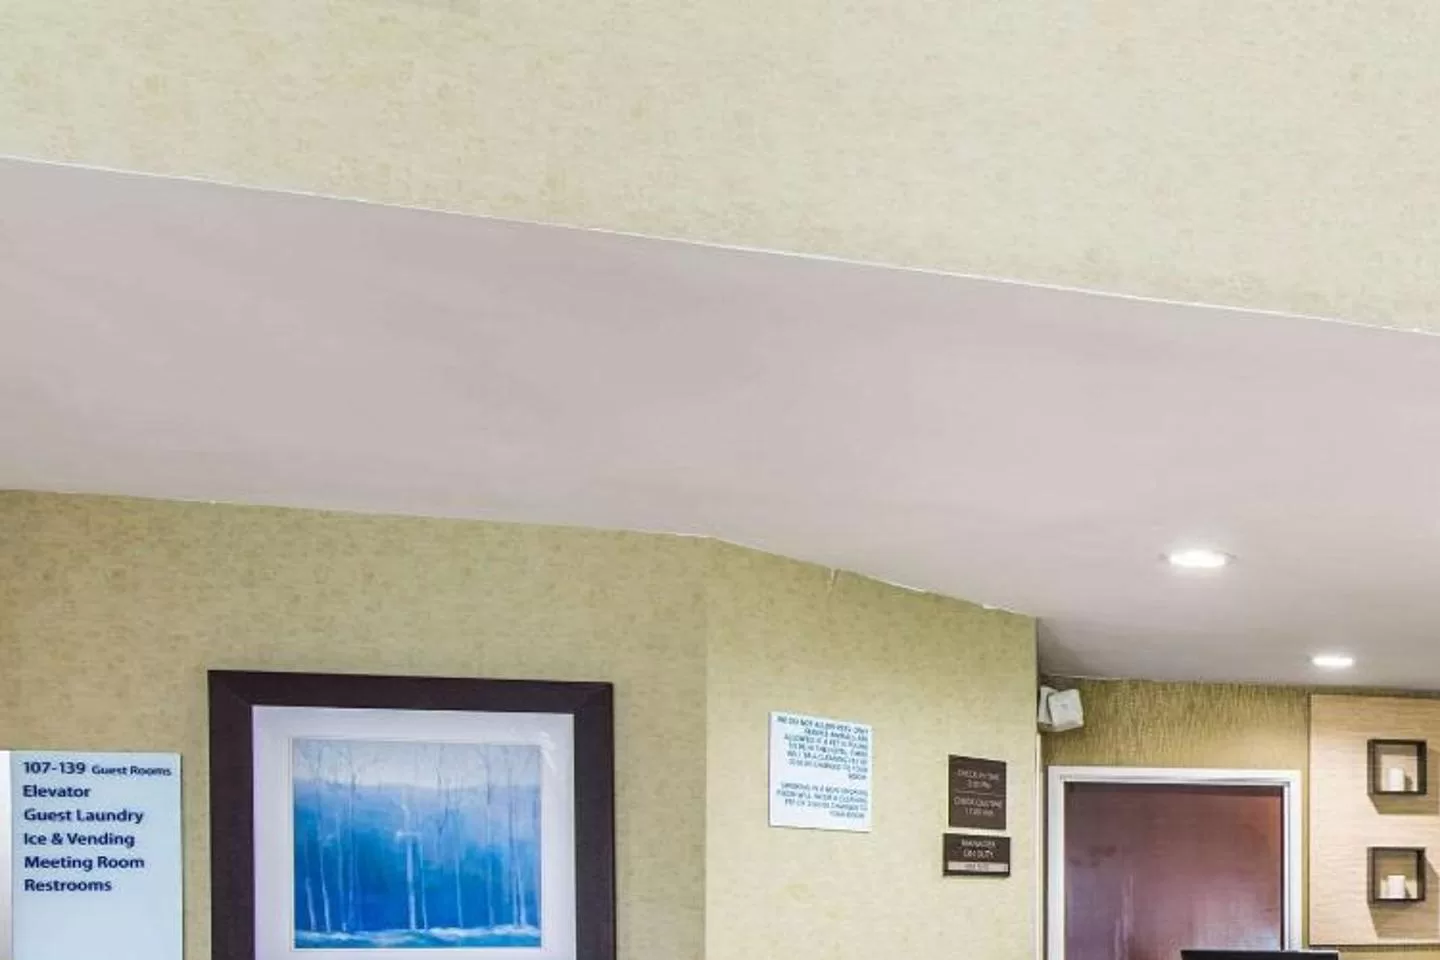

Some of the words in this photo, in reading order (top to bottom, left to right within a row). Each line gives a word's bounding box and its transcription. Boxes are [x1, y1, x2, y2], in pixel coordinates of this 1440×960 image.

[24, 761, 86, 775] 107-139
[91, 765, 127, 776] Guest
[129, 765, 172, 777] Rooms
[22, 784, 91, 798] Elevator
[24, 808, 72, 821] Guest
[76, 809, 144, 824] Laundry
[24, 832, 47, 845] Ice
[50, 832, 63, 845] &
[67, 832, 135, 848] Vending
[24, 856, 93, 872] Meeting
[97, 856, 145, 869] Room
[24, 878, 112, 892] Restrooms
